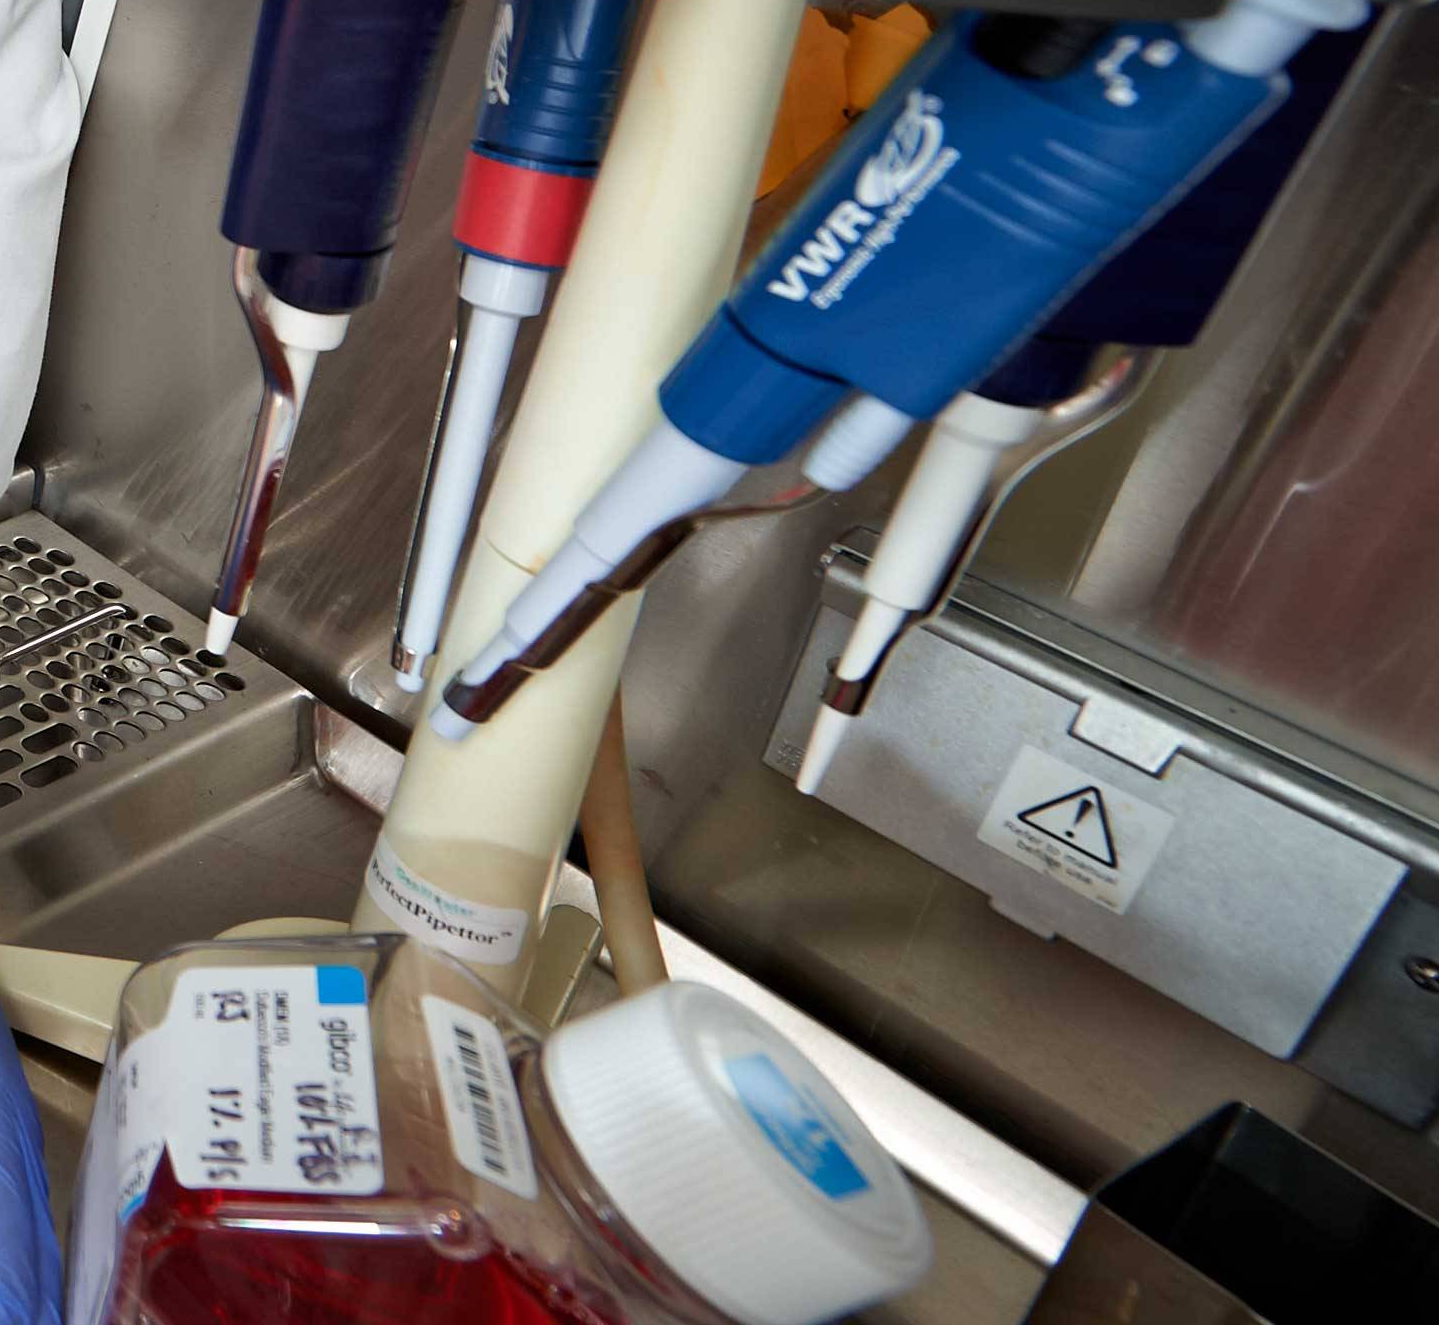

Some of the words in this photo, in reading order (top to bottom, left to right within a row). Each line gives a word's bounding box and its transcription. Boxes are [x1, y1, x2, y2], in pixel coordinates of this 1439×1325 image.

[766, 198, 878, 303] VWR
[257, 1044, 273, 1089] Modified
[319, 1018, 357, 1074] gibco
[254, 1089, 274, 1117] Eagle
[260, 1121, 275, 1164] Medium
